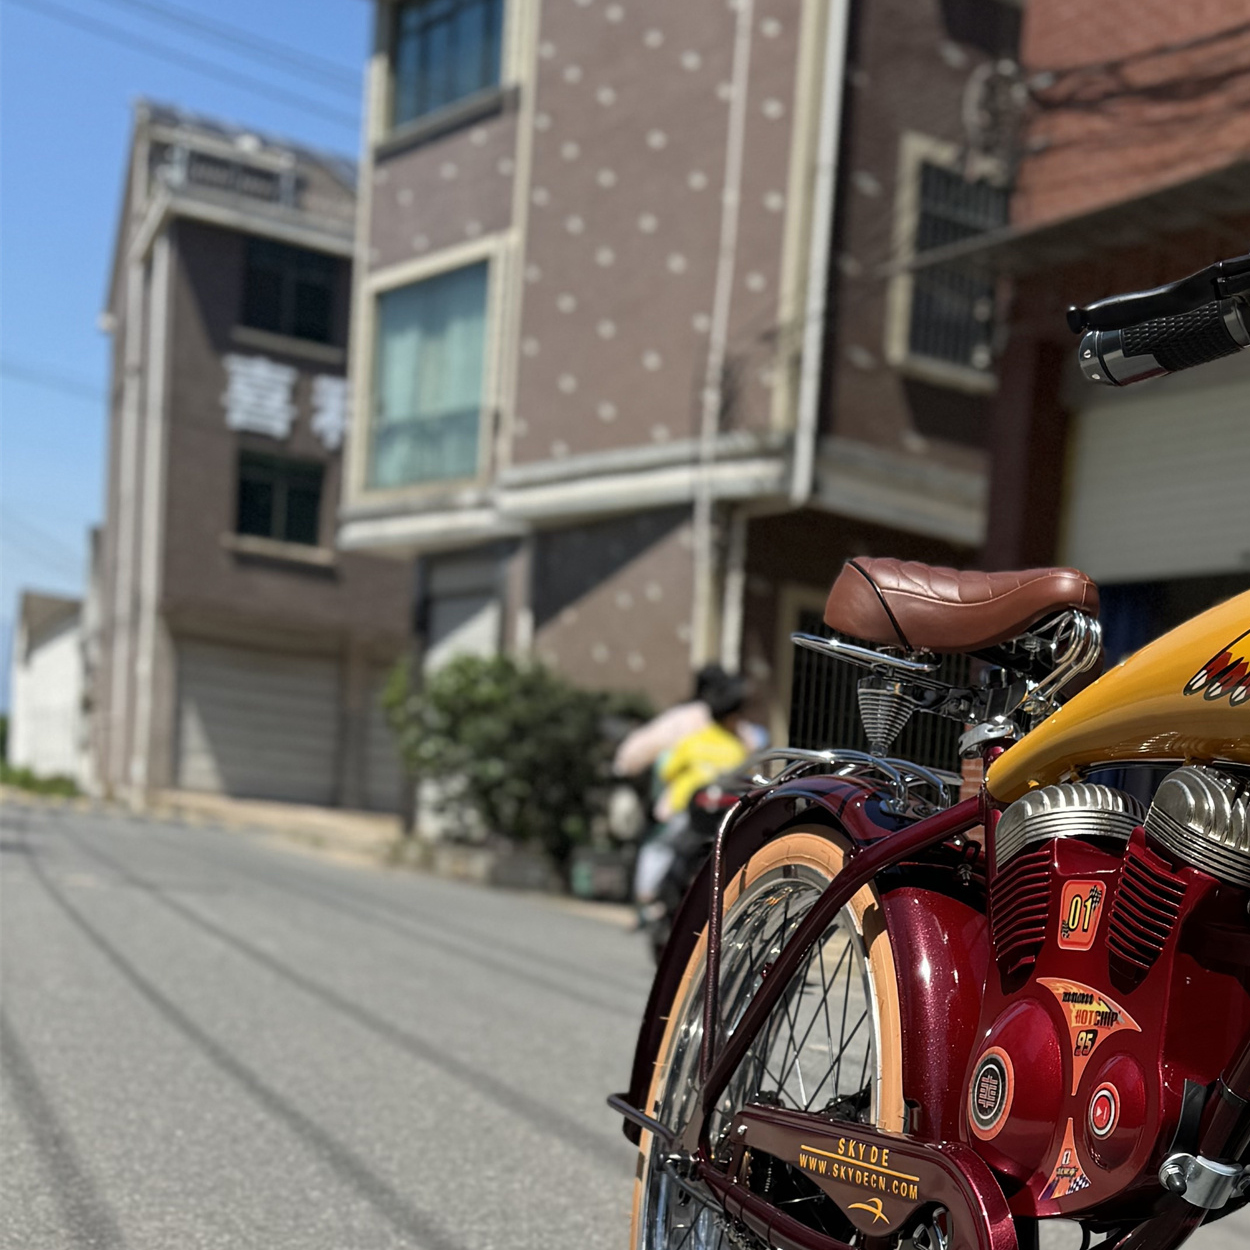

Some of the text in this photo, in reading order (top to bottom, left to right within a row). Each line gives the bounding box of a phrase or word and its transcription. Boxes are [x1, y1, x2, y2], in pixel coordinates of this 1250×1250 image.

[1067, 894, 1093, 933] 01
[1074, 1029, 1098, 1056] 95
[837, 1137, 890, 1167] SKYDE
[799, 1153, 918, 1200] WWW.SKYDECN.COM
